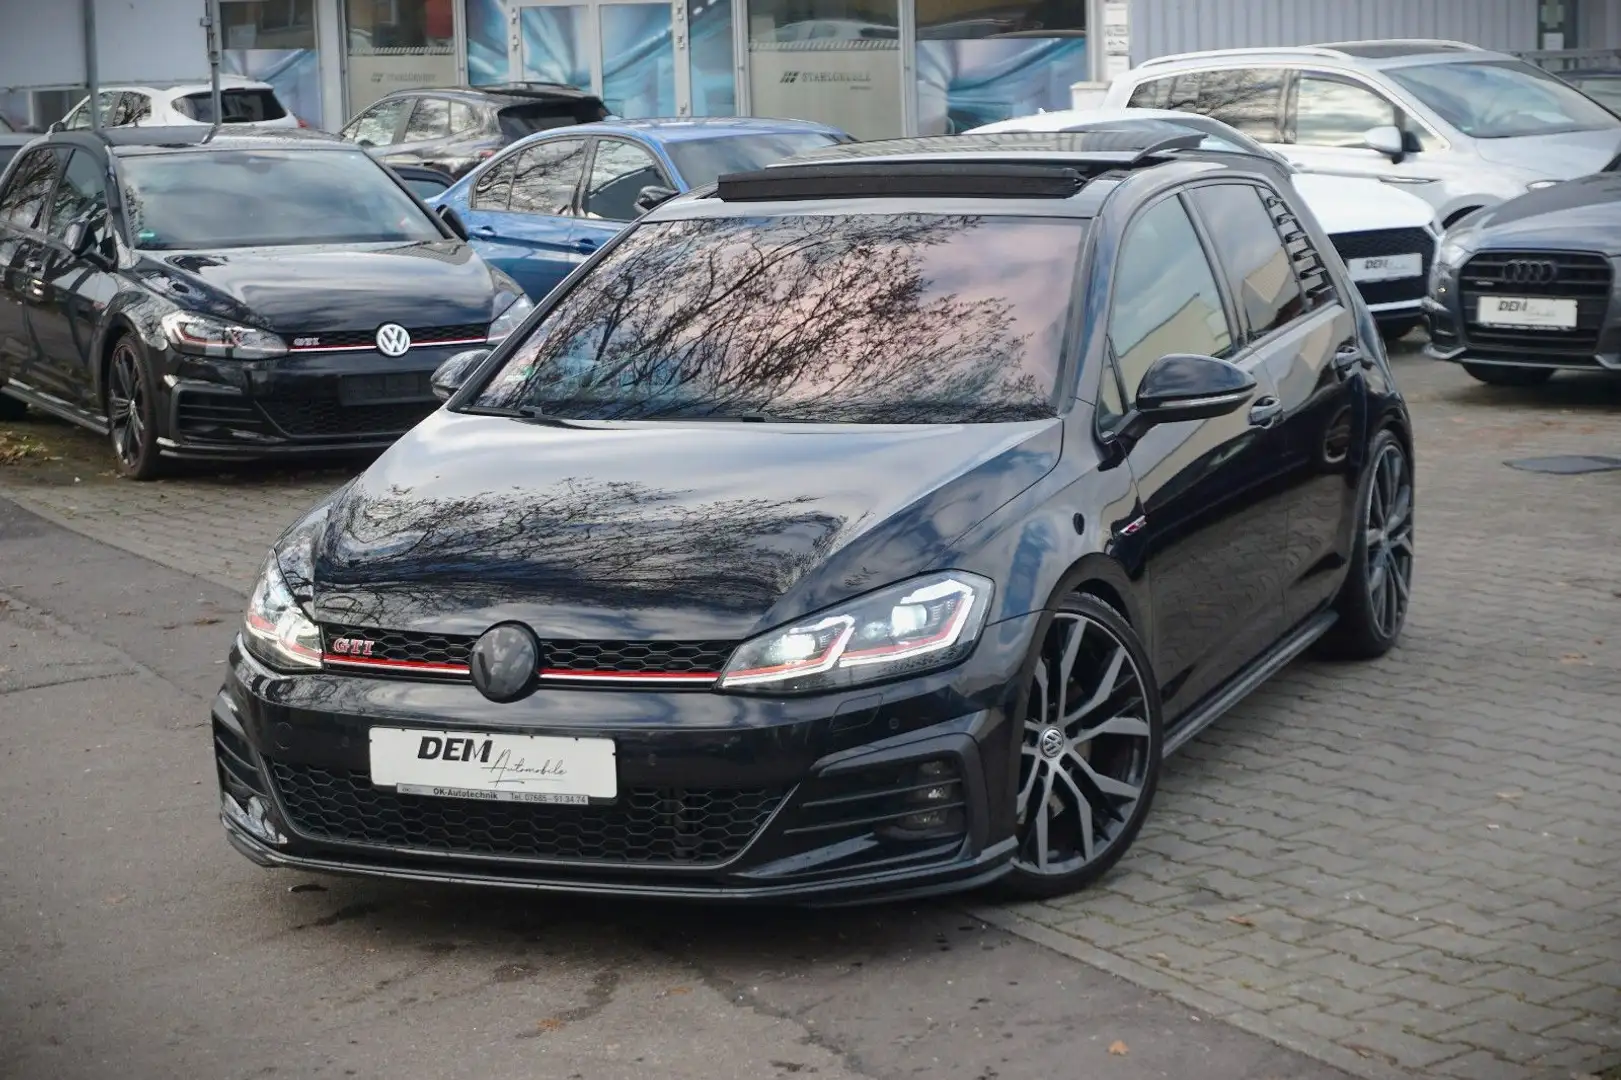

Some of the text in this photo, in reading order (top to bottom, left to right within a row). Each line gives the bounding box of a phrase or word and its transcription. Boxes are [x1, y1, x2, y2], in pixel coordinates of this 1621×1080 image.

[332, 637, 375, 656] GTI
[417, 736, 567, 786] DEM Automobile
[433, 787, 499, 800] OK-Autotechnik
